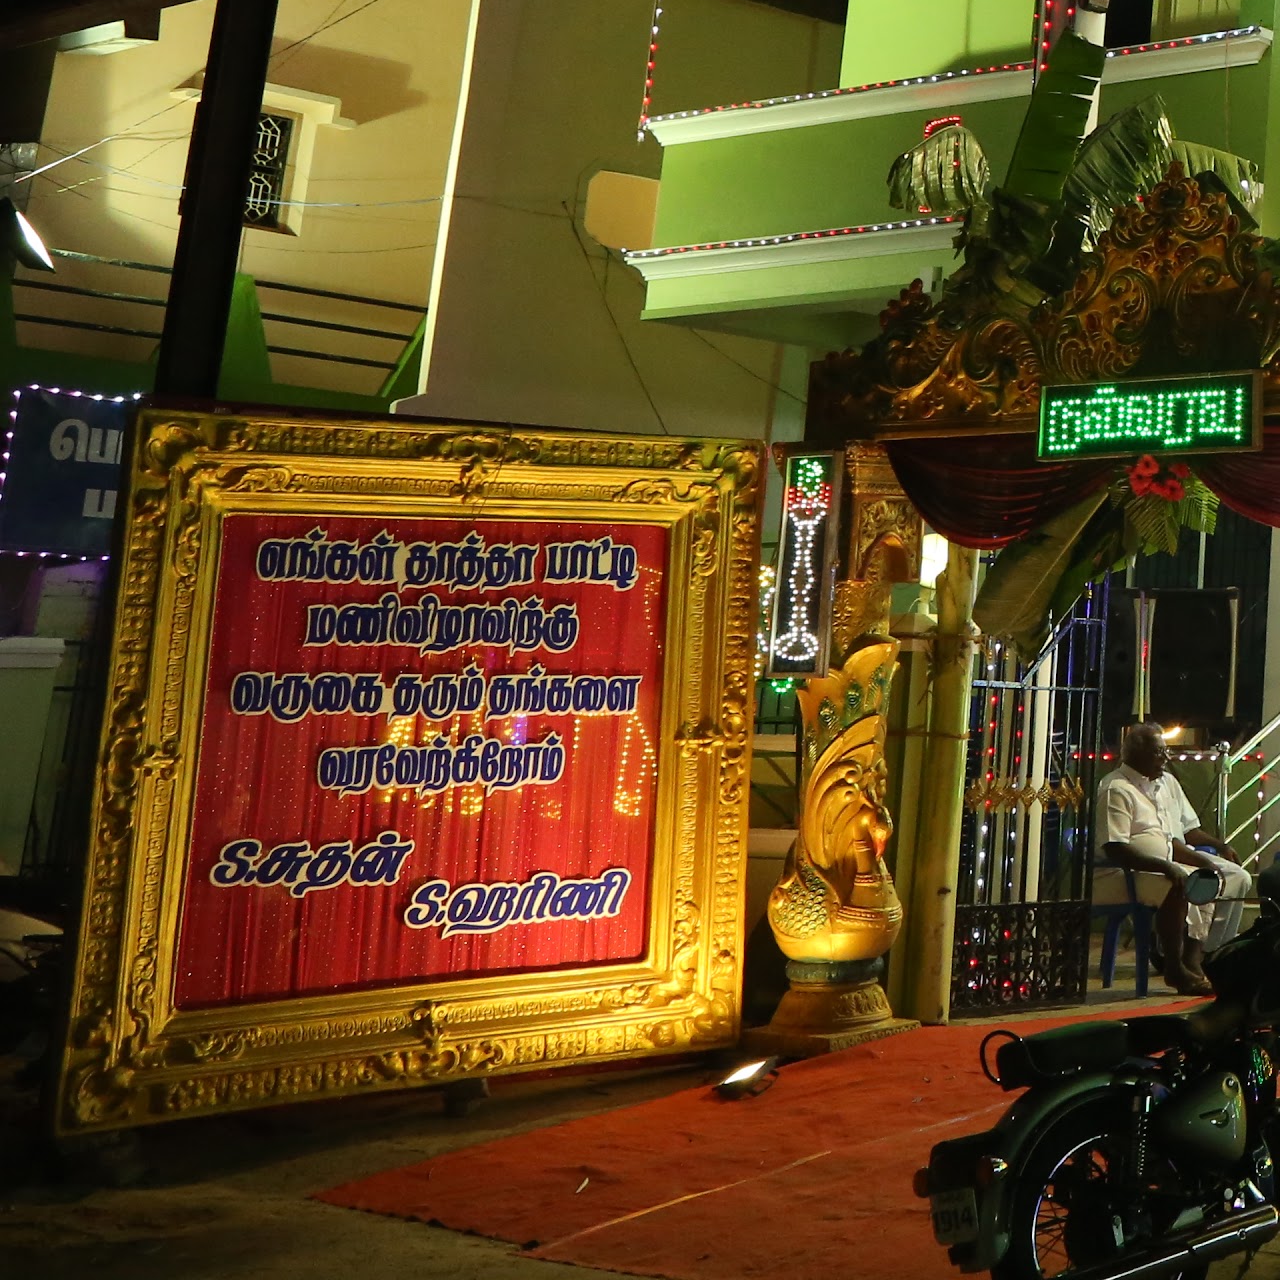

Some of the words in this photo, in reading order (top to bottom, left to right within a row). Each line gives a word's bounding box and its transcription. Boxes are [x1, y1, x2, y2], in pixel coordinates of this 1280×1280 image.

[1048, 387, 1243, 452] நல்வரவு
[256, 526, 398, 584] எங்கள்
[401, 530, 540, 593] தாத்தா
[543, 535, 640, 590] பாட்டி
[303, 592, 580, 657] மணிவிழாவிற்கு
[230, 671, 384, 721] வருகை
[387, 665, 485, 724] தரும்
[485, 663, 643, 723] தங்களை
[317, 731, 566, 800] வரவேற்கிறோம்
[209, 830, 415, 898] S.சுதன்
[404, 866, 632, 940] S.ஹரிணி
